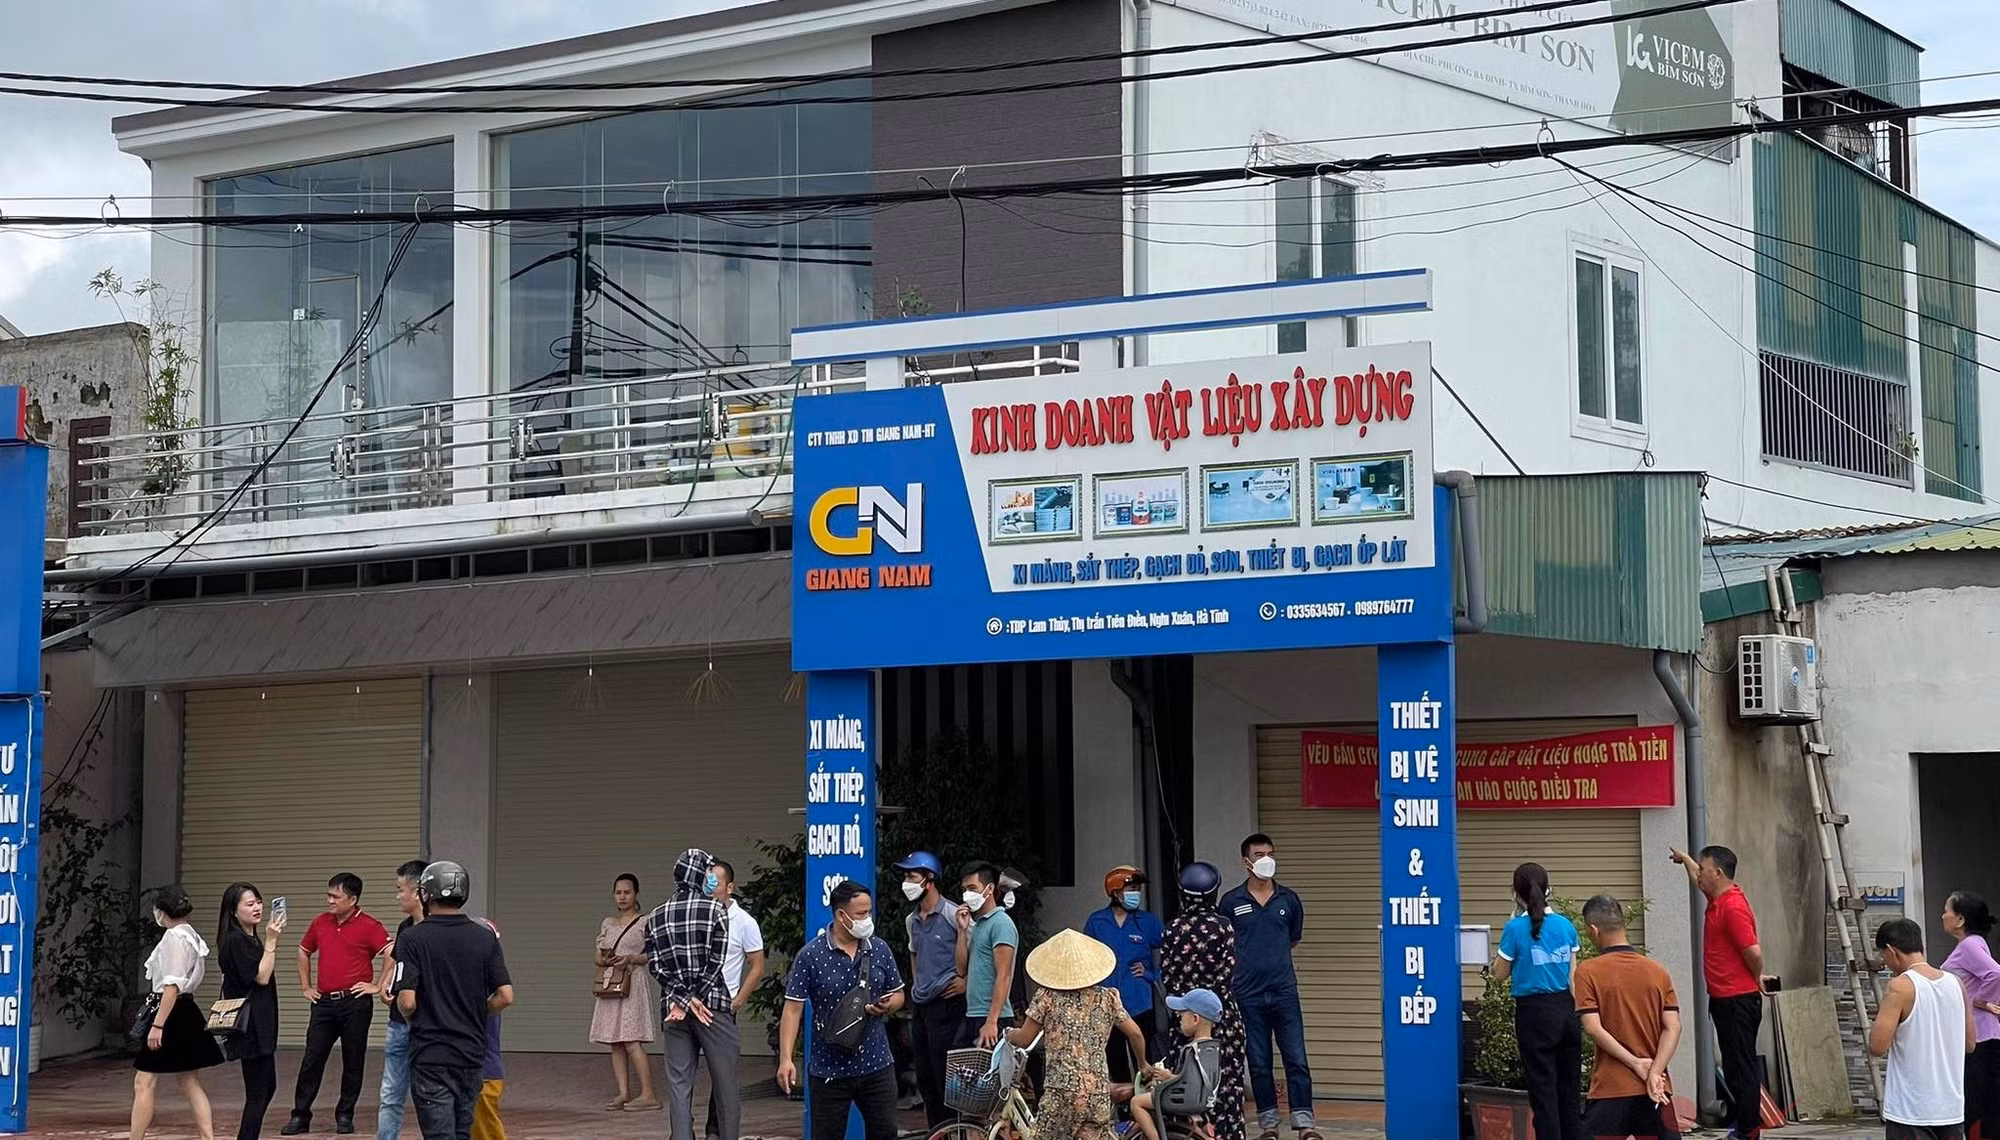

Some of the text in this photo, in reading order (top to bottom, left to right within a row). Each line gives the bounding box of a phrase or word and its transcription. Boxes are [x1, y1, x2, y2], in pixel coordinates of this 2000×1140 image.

[1541, 35, 1594, 73] SƠN
[1653, 35, 1705, 72] VICEM
[1682, 70, 1705, 88] SƠN
[970, 363, 1414, 455] KINH DOANH VẬT LIỆU XÂY DỰNG
[807, 423, 936, 447] CTY TNHH XD TM GIANG NAM-HT
[806, 564, 932, 590] GIANG NAM
[1013, 534, 1407, 584] XI MĂNG, SẮT THÉP, GẠCH ĐỎ, SƠN, THIẾT BỊ, GẠCH ỐP LÁT
[1028, 619, 1046, 632] Lam
[1071, 616, 1085, 632] Thị
[1086, 611, 1104, 630] trấn
[1106, 614, 1125, 628] Tiên
[1149, 612, 1169, 628] Nghi
[1196, 608, 1208, 624] Hà
[1209, 608, 1229, 623] Tĩnh
[1287, 603, 1345, 619] 0335634567
[1355, 599, 1414, 616] 0989764777
[1390, 691, 1441, 729] THIẾT
[809, 714, 865, 753] XI MĂNG,
[1308, 740, 1330, 765] YÊU
[1517, 745, 1541, 770] VẬT
[1543, 743, 1571, 769] LIỆU
[1574, 741, 1608, 768] HOẶC
[1611, 736, 1637, 762] TRẢ
[1639, 732, 1667, 761] TIỀN
[1390, 744, 1439, 782] BỊ VỆ
[809, 762, 865, 806] SẮT THÉP,
[1476, 777, 1500, 801] VÀO
[1504, 776, 1538, 805] CUỘC
[1541, 772, 1571, 800] ĐIỀU
[1574, 778, 1598, 800] TRA
[1393, 799, 1439, 827] SINH
[809, 814, 864, 859] GẠCH ĐỎ,
[1408, 848, 1424, 876] &
[1389, 886, 1441, 925] THIẾT
[1405, 946, 1424, 979] BỊ
[1400, 985, 1436, 1024] BẾP
